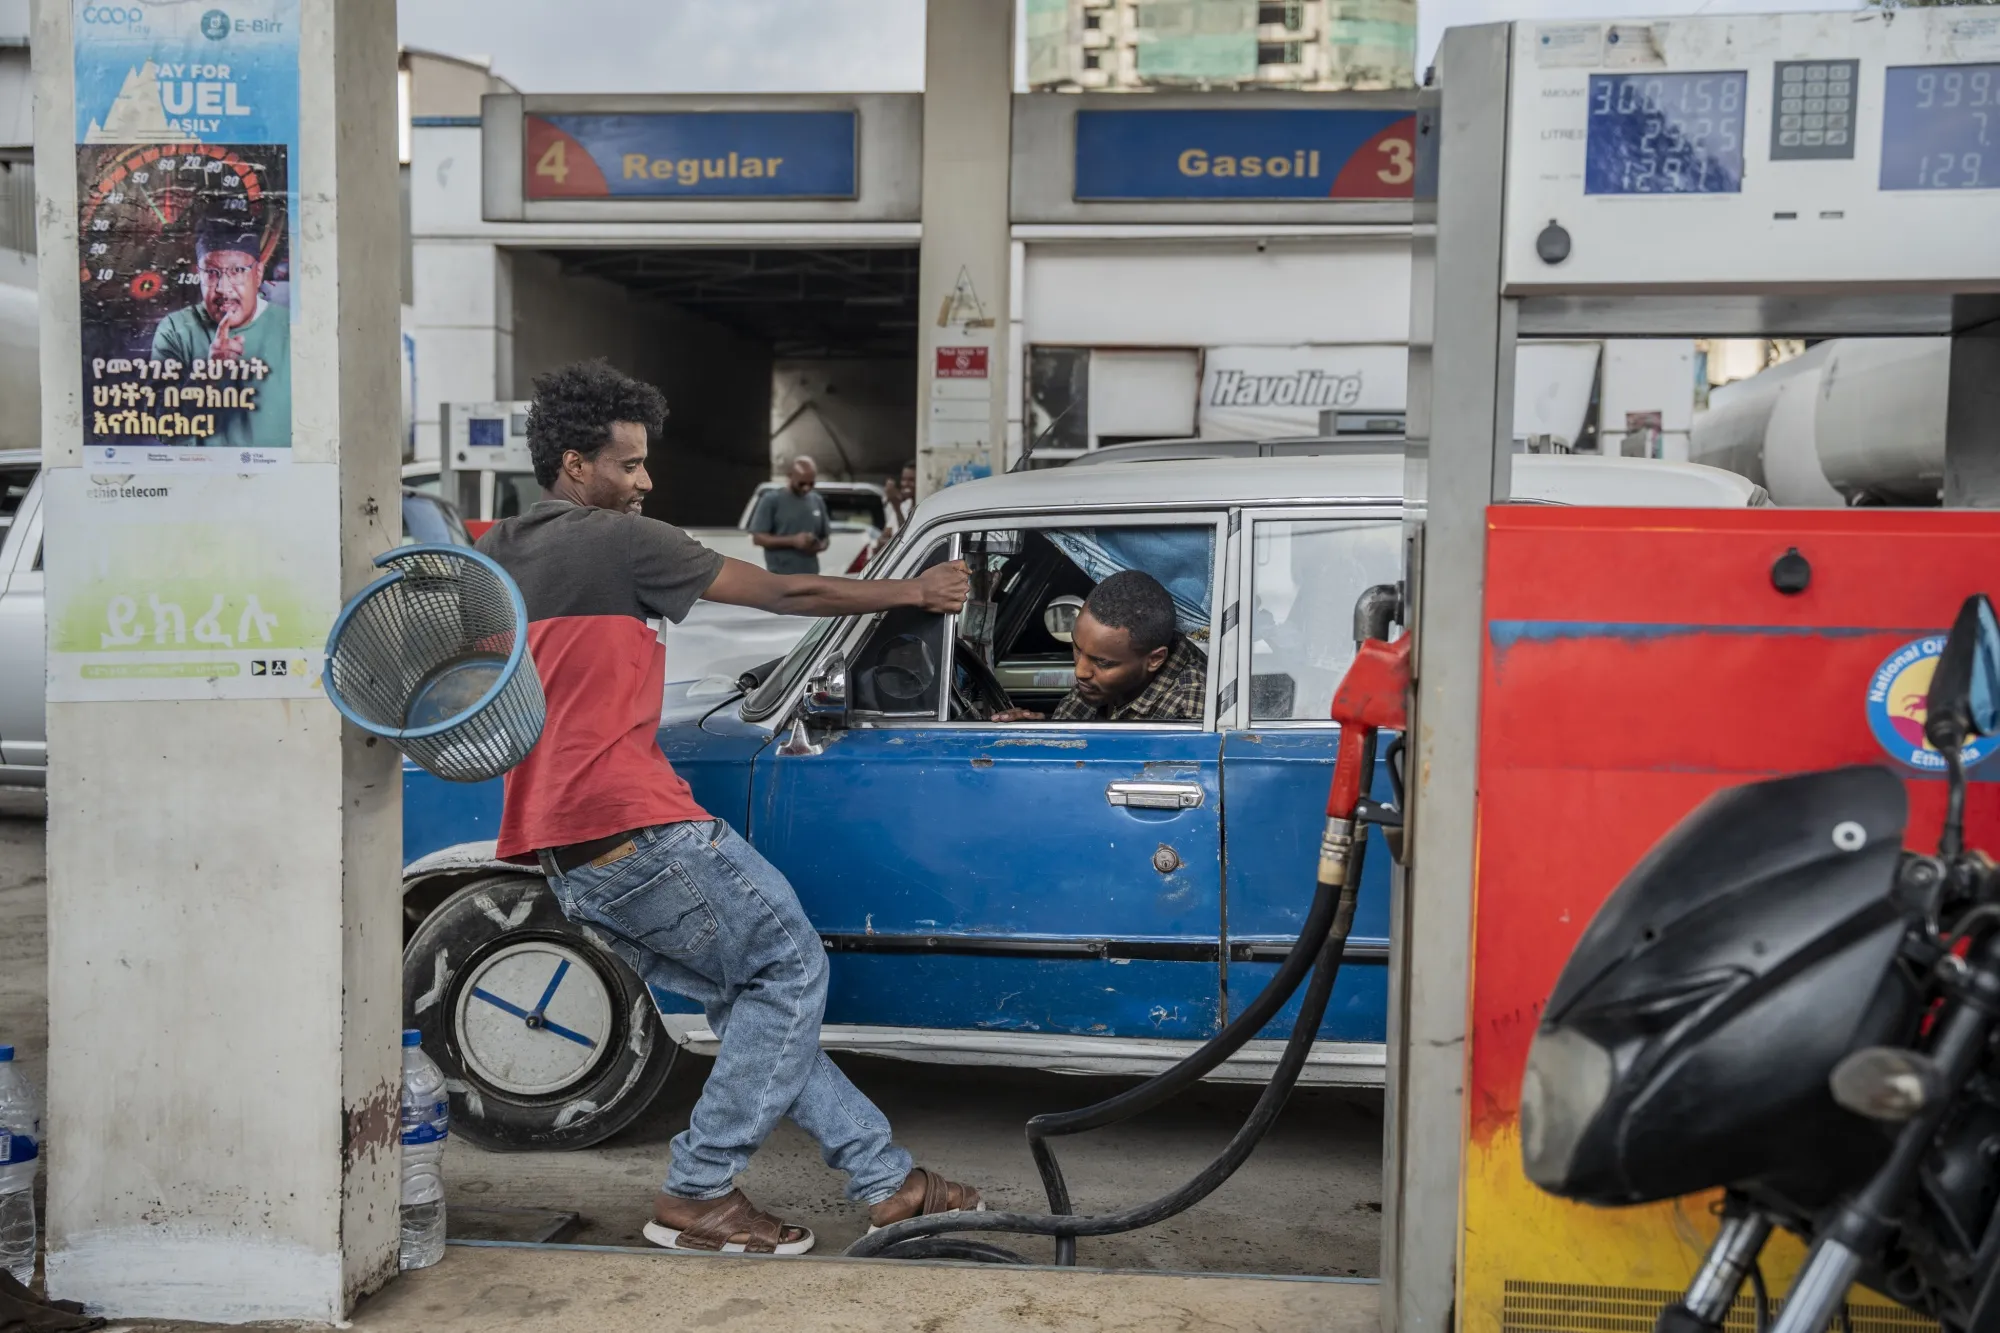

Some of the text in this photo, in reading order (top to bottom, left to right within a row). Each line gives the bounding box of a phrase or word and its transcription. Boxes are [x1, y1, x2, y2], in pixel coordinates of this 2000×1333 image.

[234, 18, 283, 33] E-Birr
[191, 64, 230, 79] FOR
[157, 82, 250, 116] UEL
[1915, 71, 2000, 108] 999.
[166, 118, 221, 133] ASILY
[158, 159, 176, 171] 60
[535, 140, 783, 186] 4 Regular
[1178, 137, 1414, 185] Gasoil 3
[132, 171, 149, 184] 50
[222, 175, 240, 187] 90
[92, 356, 269, 381] የመንገድ ደህንነት
[163, 385, 256, 410] በማክበር
[1210, 369, 1362, 407] Havoline
[120, 486, 168, 499] telecom
[100, 593, 280, 649] ይክፈሉ
[1869, 645, 1920, 703] National
